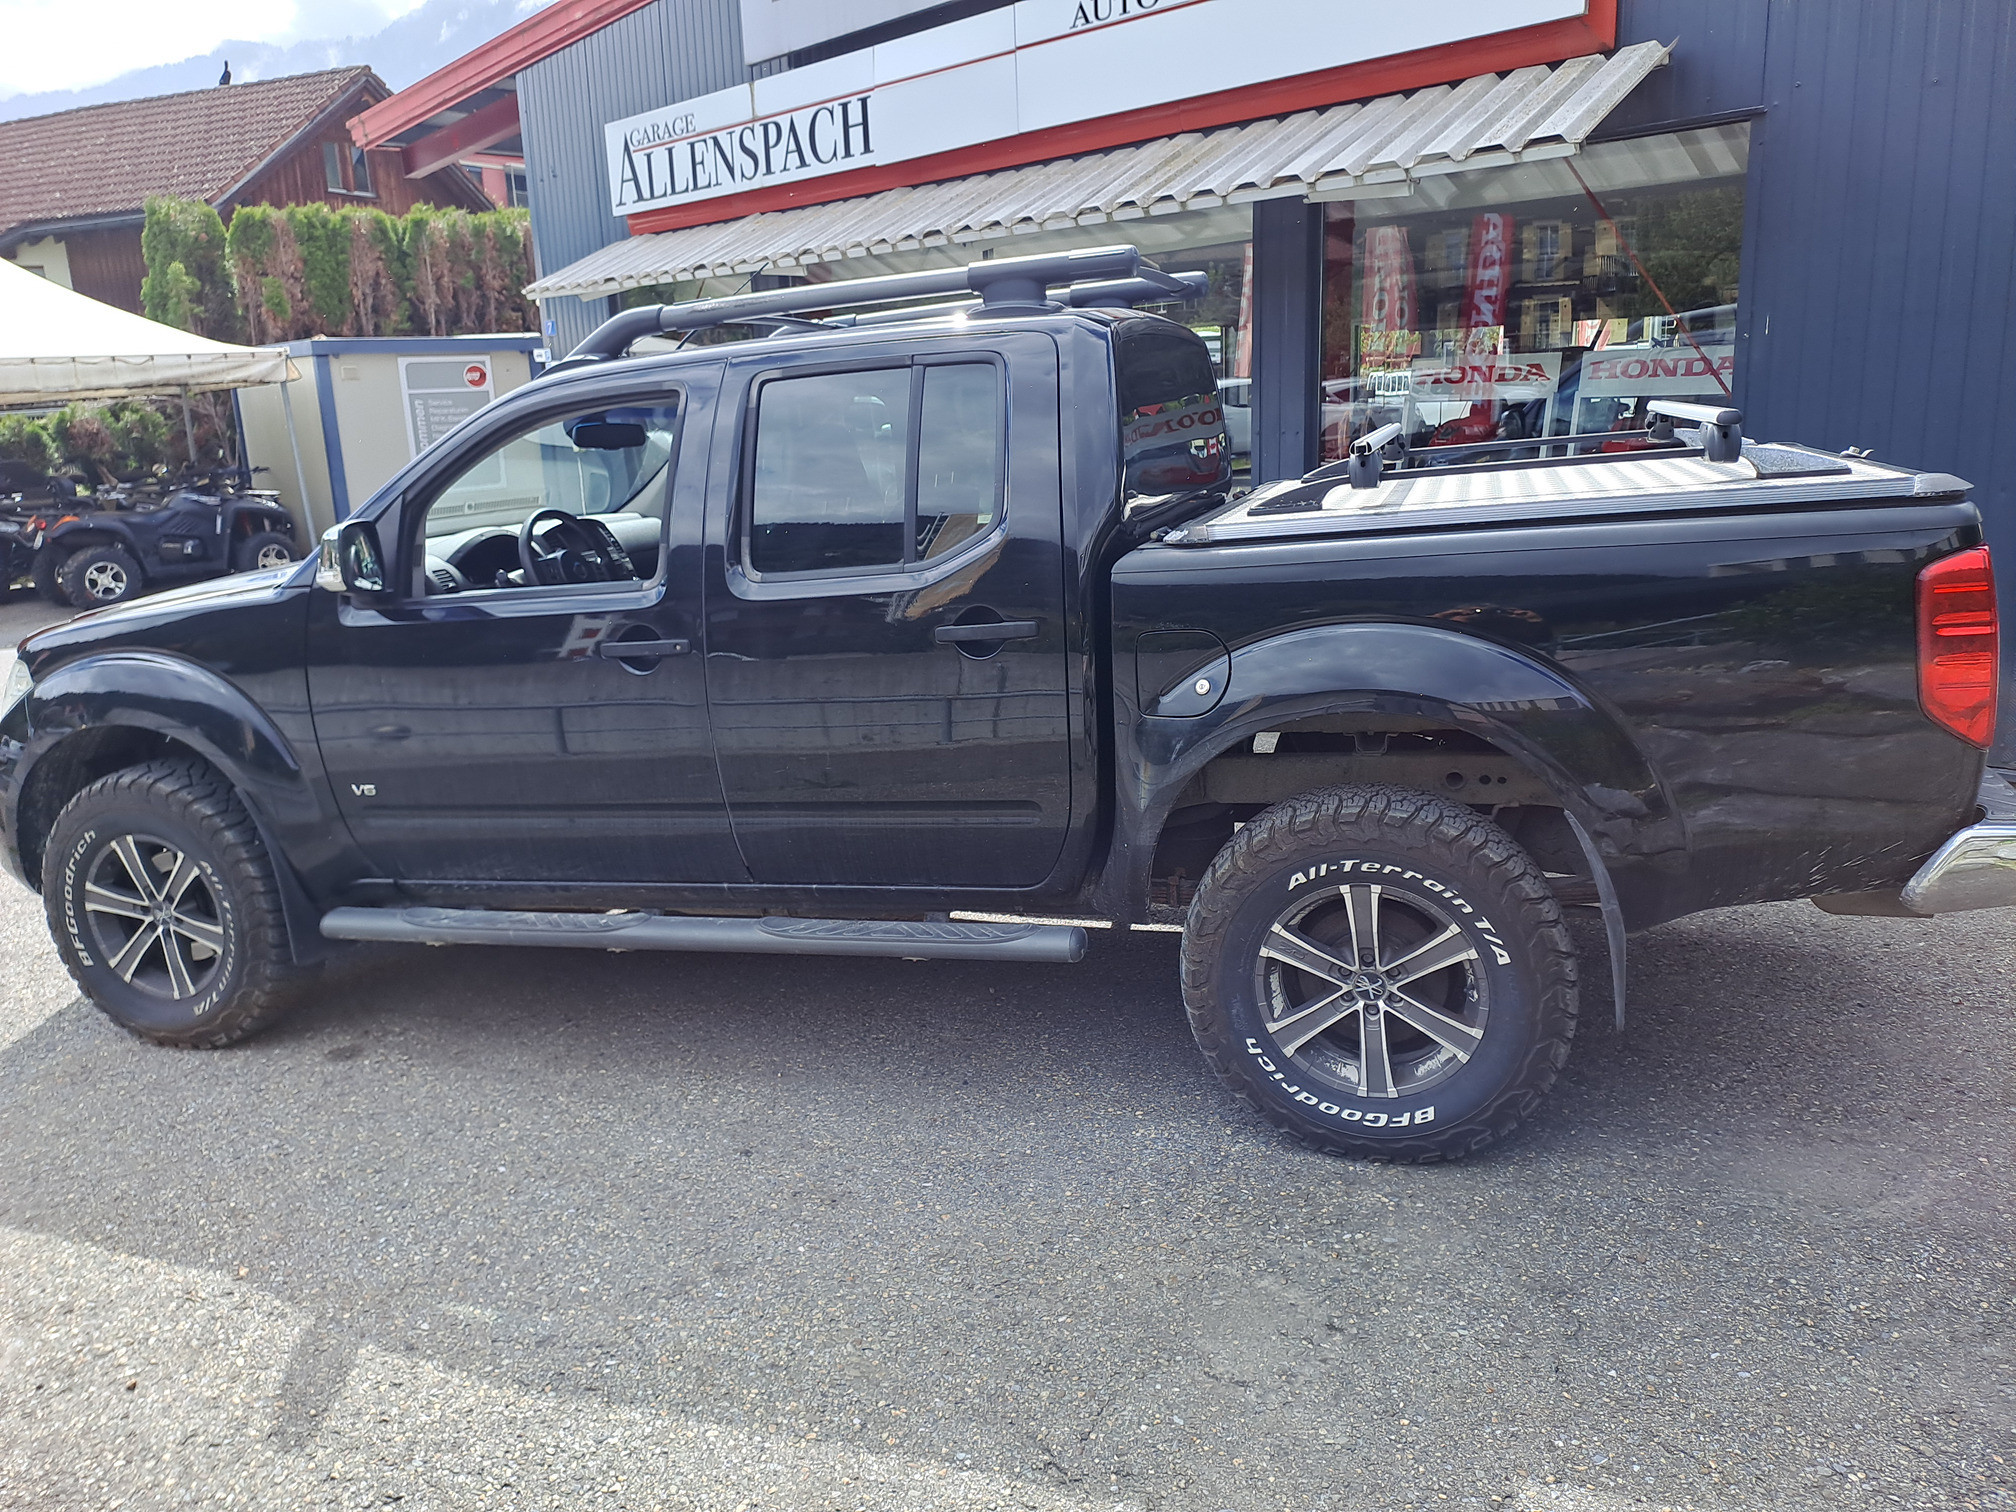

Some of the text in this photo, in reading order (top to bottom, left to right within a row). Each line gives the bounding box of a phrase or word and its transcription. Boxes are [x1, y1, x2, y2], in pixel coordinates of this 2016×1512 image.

[615, 95, 875, 207] ALLENSPACH
[629, 113, 697, 148] GARAGE
[351, 783, 376, 796] V6
[64, 829, 96, 967] BFGoodrich
[1287, 858, 1512, 966] All-Terrain T/A
[1245, 1037, 1436, 1129] BFGoodrich
